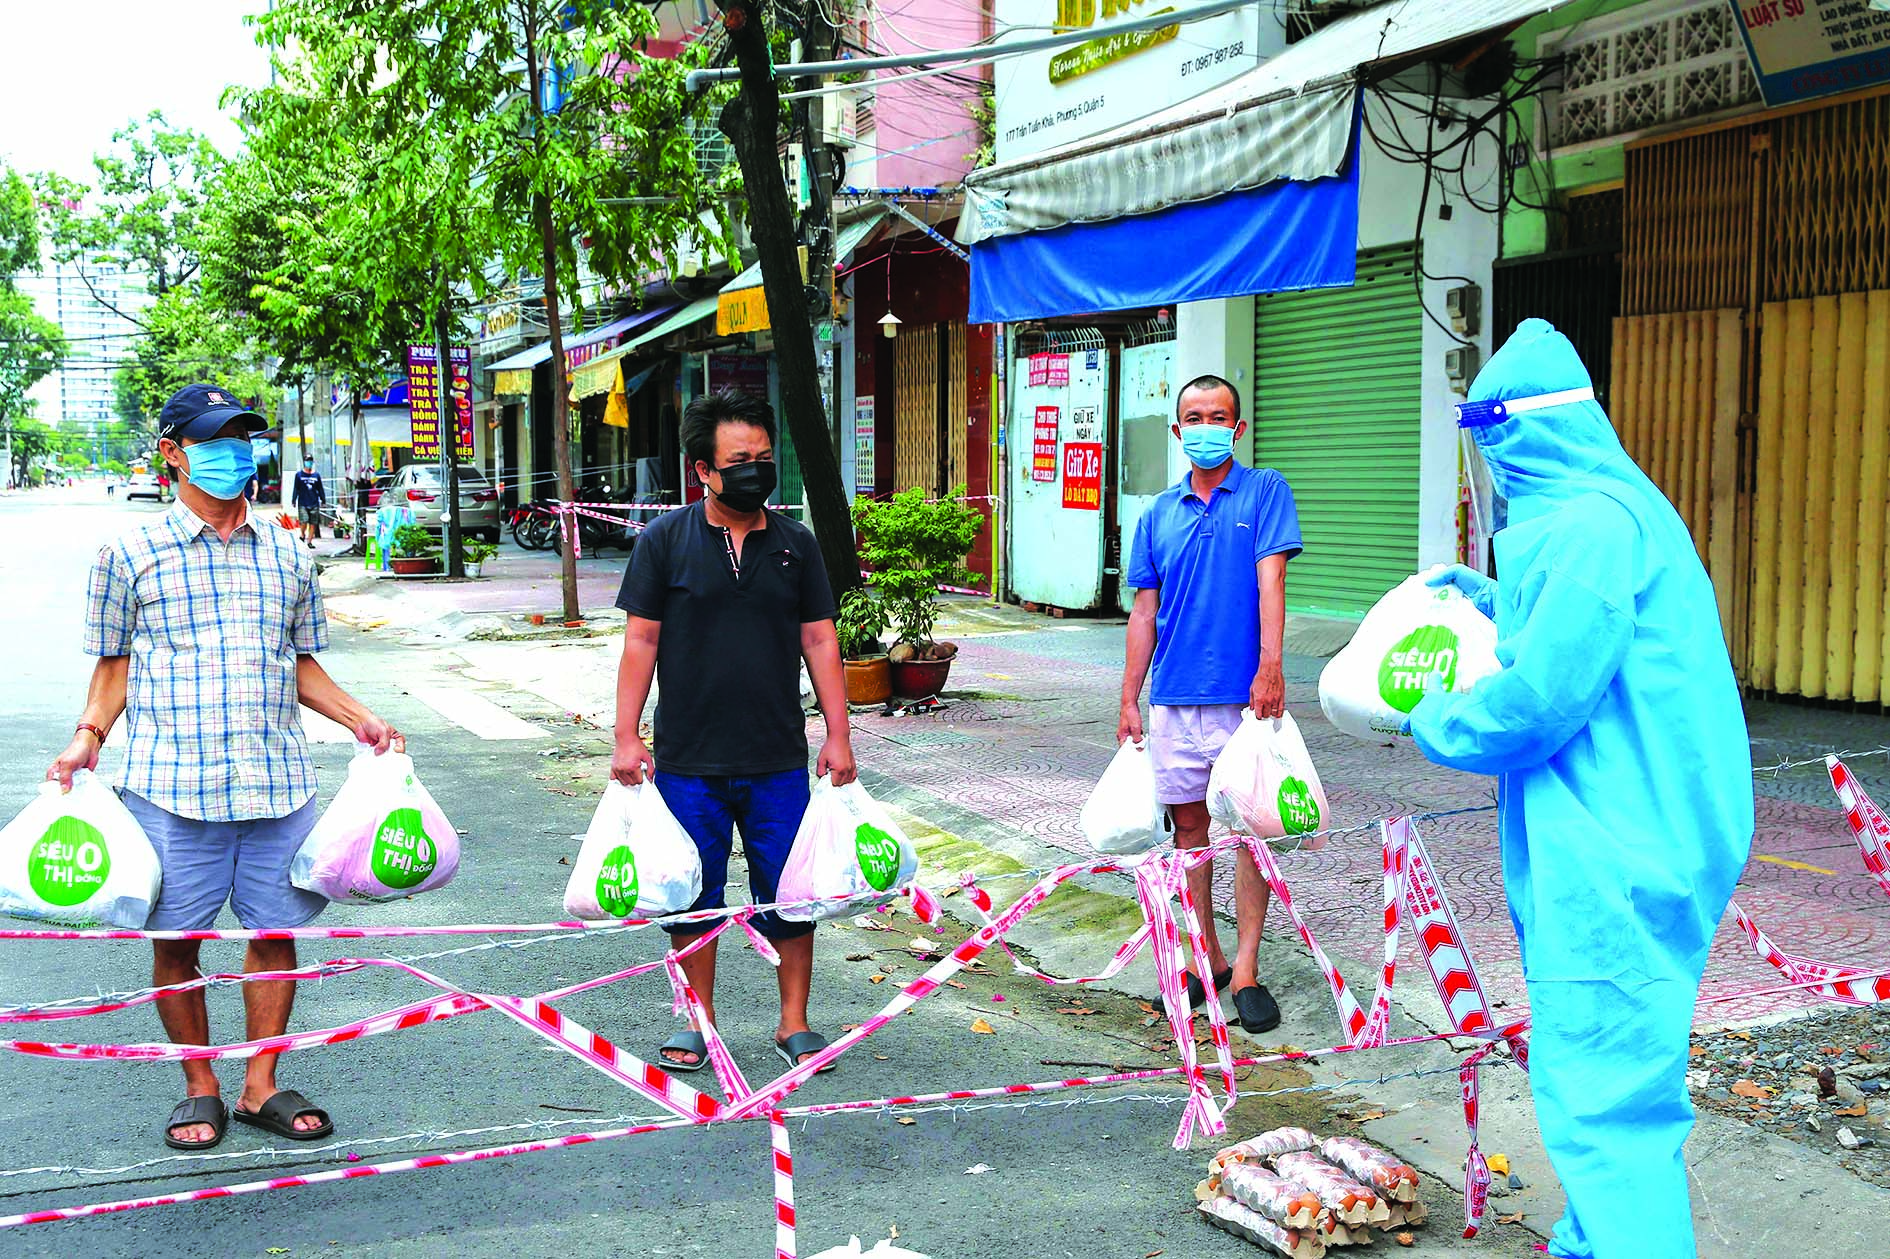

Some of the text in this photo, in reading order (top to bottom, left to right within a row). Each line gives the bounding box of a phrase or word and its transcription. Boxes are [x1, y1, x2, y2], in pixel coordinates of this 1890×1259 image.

[1742, 1, 1781, 28] LUẬT
[1819, 8, 1838, 22] LAO
[1181, 60, 1194, 77] ĐT:
[1214, 46, 1228, 64] 987
[1229, 40, 1244, 58] 258
[1006, 129, 1015, 142] 177
[1100, 95, 1105, 108] 5
[410, 364, 428, 374] TRÀ
[411, 376, 429, 386] TRÀ
[411, 388, 429, 398] TRÀ
[412, 400, 432, 410] TRÀ
[1074, 410, 1094, 424] GIỮ XE
[1077, 425, 1091, 440] NGÀY
[1066, 448, 1085, 478] Giữ
[1085, 449, 1099, 478] Xe
[1086, 487, 1098, 506] BBQ
[1389, 647, 1434, 667] SIÊU
[380, 825, 431, 862] SIÊU 0
[38, 839, 103, 872] SIÊU 0
[383, 848, 413, 875] THỊ
[43, 863, 73, 888] THỊ
